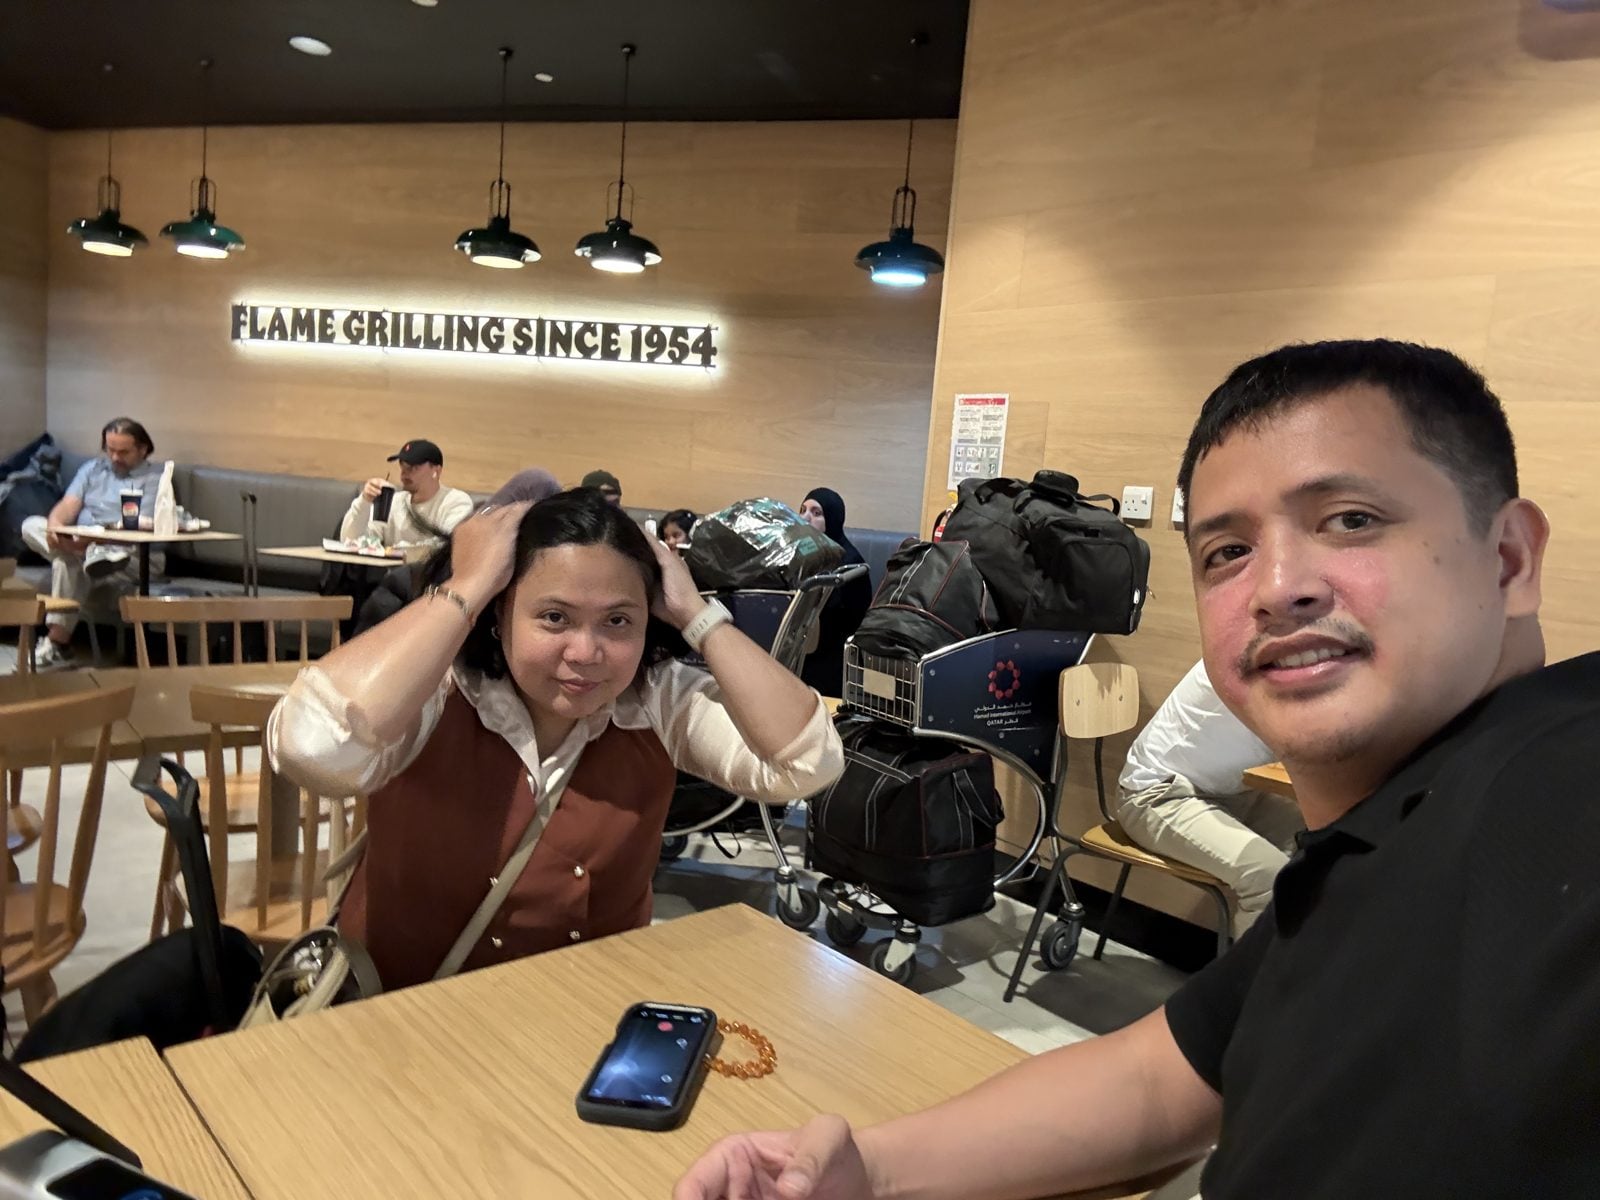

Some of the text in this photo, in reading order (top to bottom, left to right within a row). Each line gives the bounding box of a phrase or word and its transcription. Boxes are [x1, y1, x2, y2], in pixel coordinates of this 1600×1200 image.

[231, 305, 718, 367] FLAME GRILLING SINCE 1954
